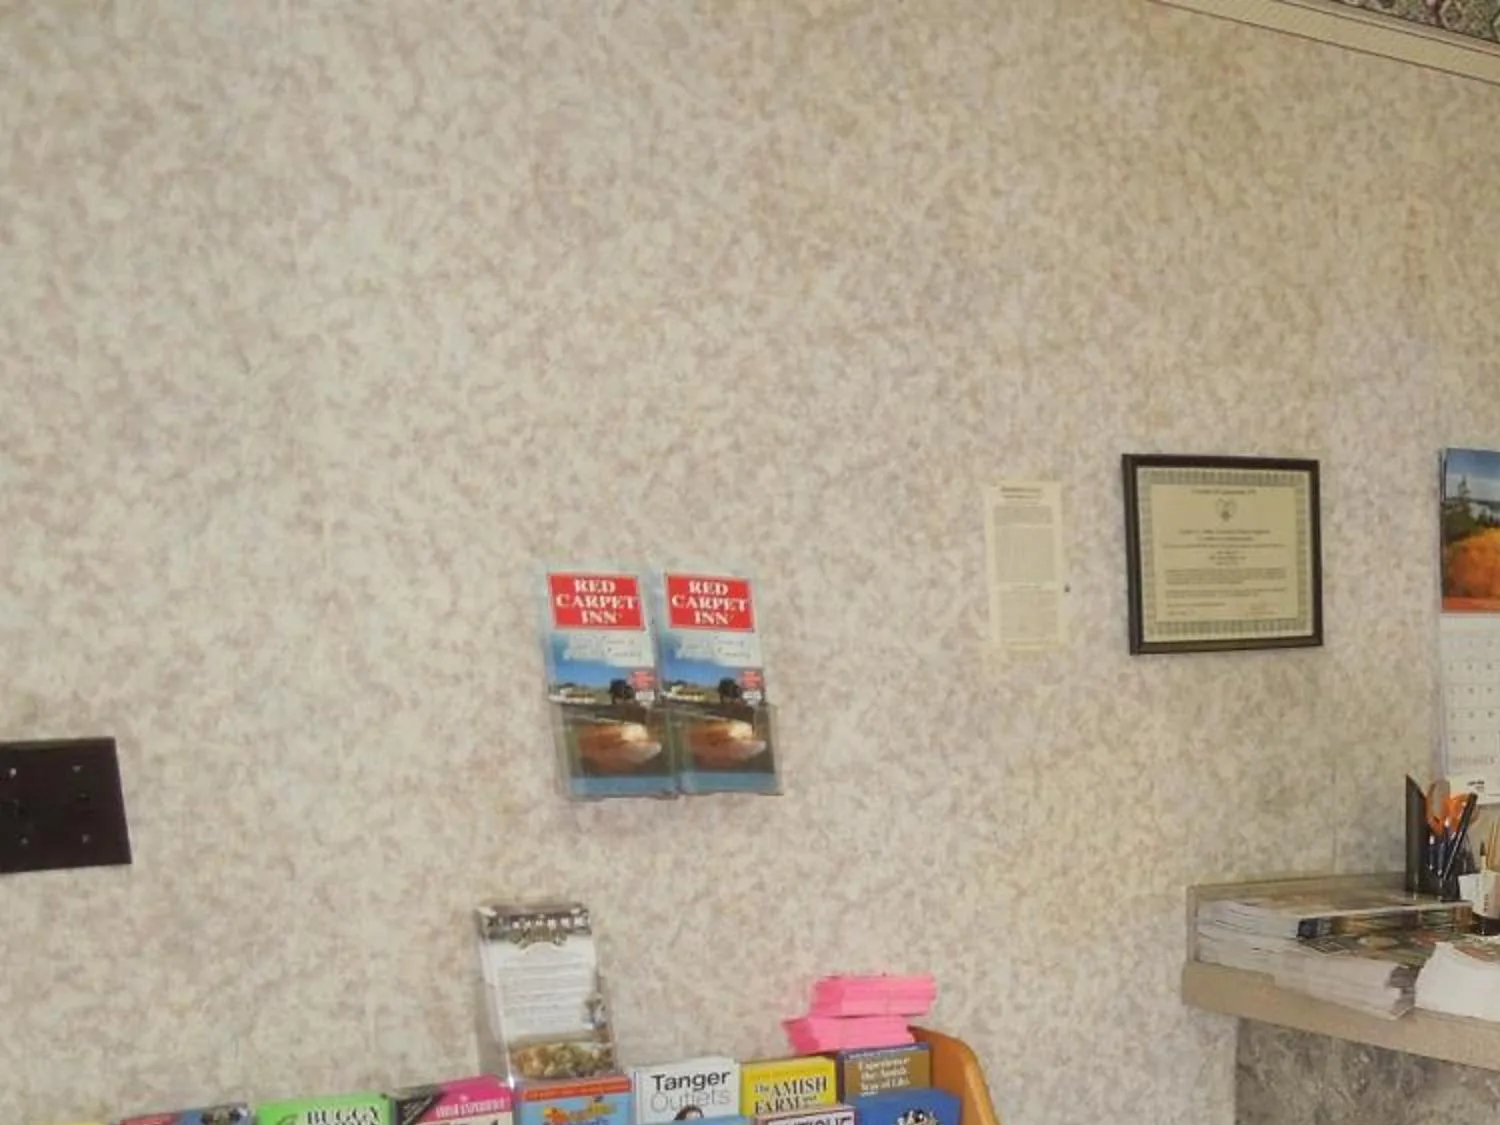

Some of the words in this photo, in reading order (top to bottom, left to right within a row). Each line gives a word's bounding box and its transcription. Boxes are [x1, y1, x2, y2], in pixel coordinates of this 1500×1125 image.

[574, 579, 616, 594] RED
[688, 580, 728, 596] RED
[555, 594, 638, 610] CARPET
[671, 595, 749, 612] CARPET
[581, 610, 622, 625] INN
[693, 611, 732, 625] INN
[651, 1069, 732, 1092] Tanger
[771, 1075, 828, 1098] AMISH
[650, 1087, 731, 1113] Outlets
[754, 1096, 801, 1115] FARM
[306, 1106, 381, 1125] BUGGY
